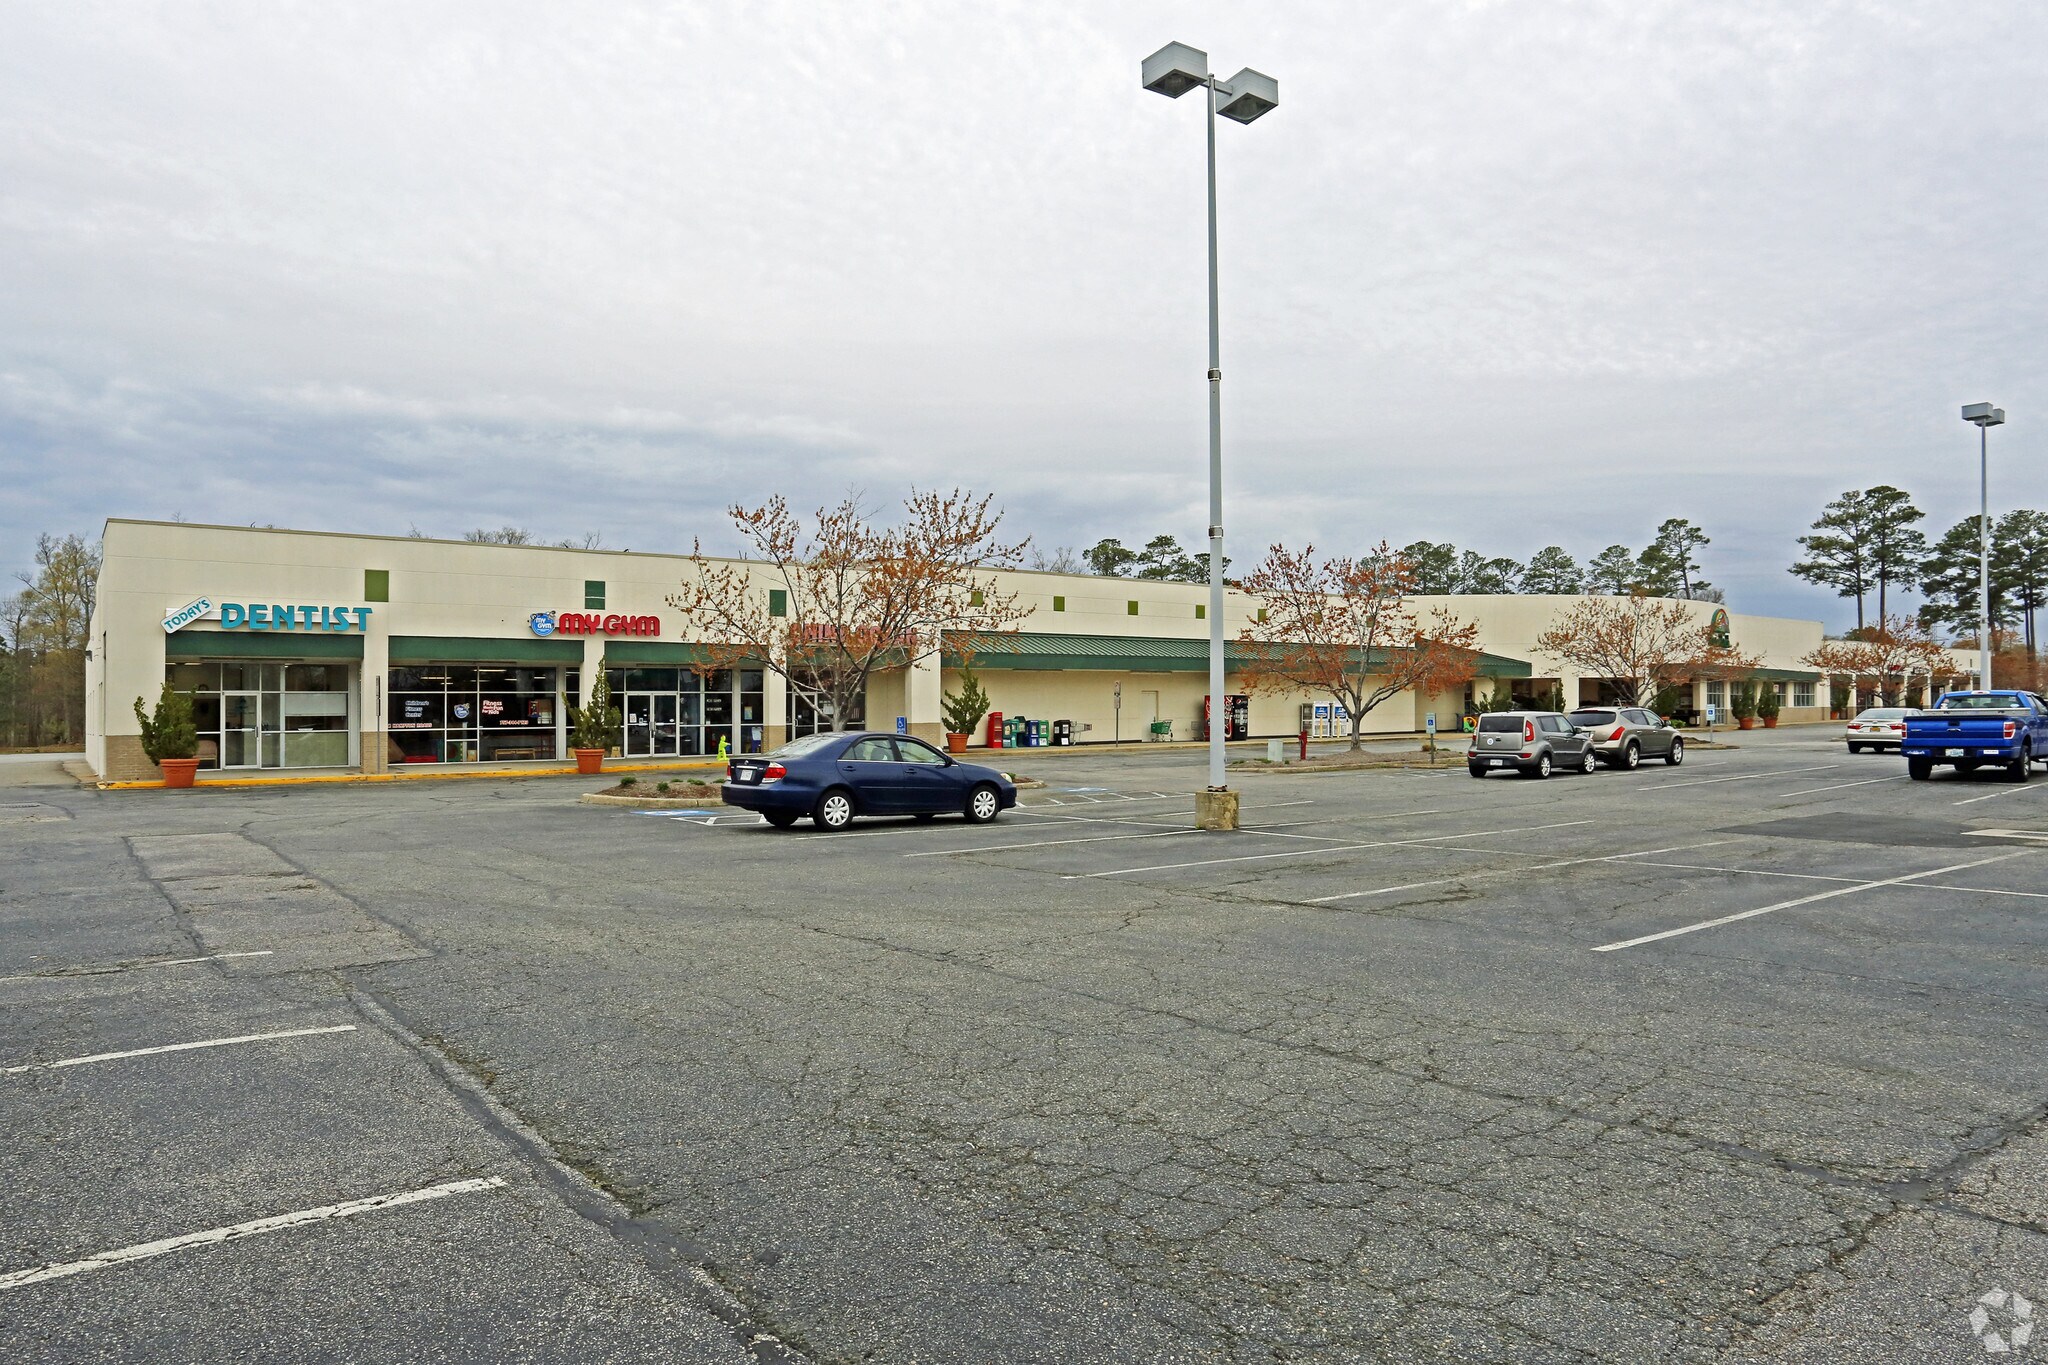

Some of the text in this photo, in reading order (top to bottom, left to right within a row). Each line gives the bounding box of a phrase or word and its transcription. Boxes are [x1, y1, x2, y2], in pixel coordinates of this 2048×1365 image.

[164, 599, 211, 630] TODAY'S
[221, 603, 373, 631] DENTIST
[603, 614, 660, 636] GYM
